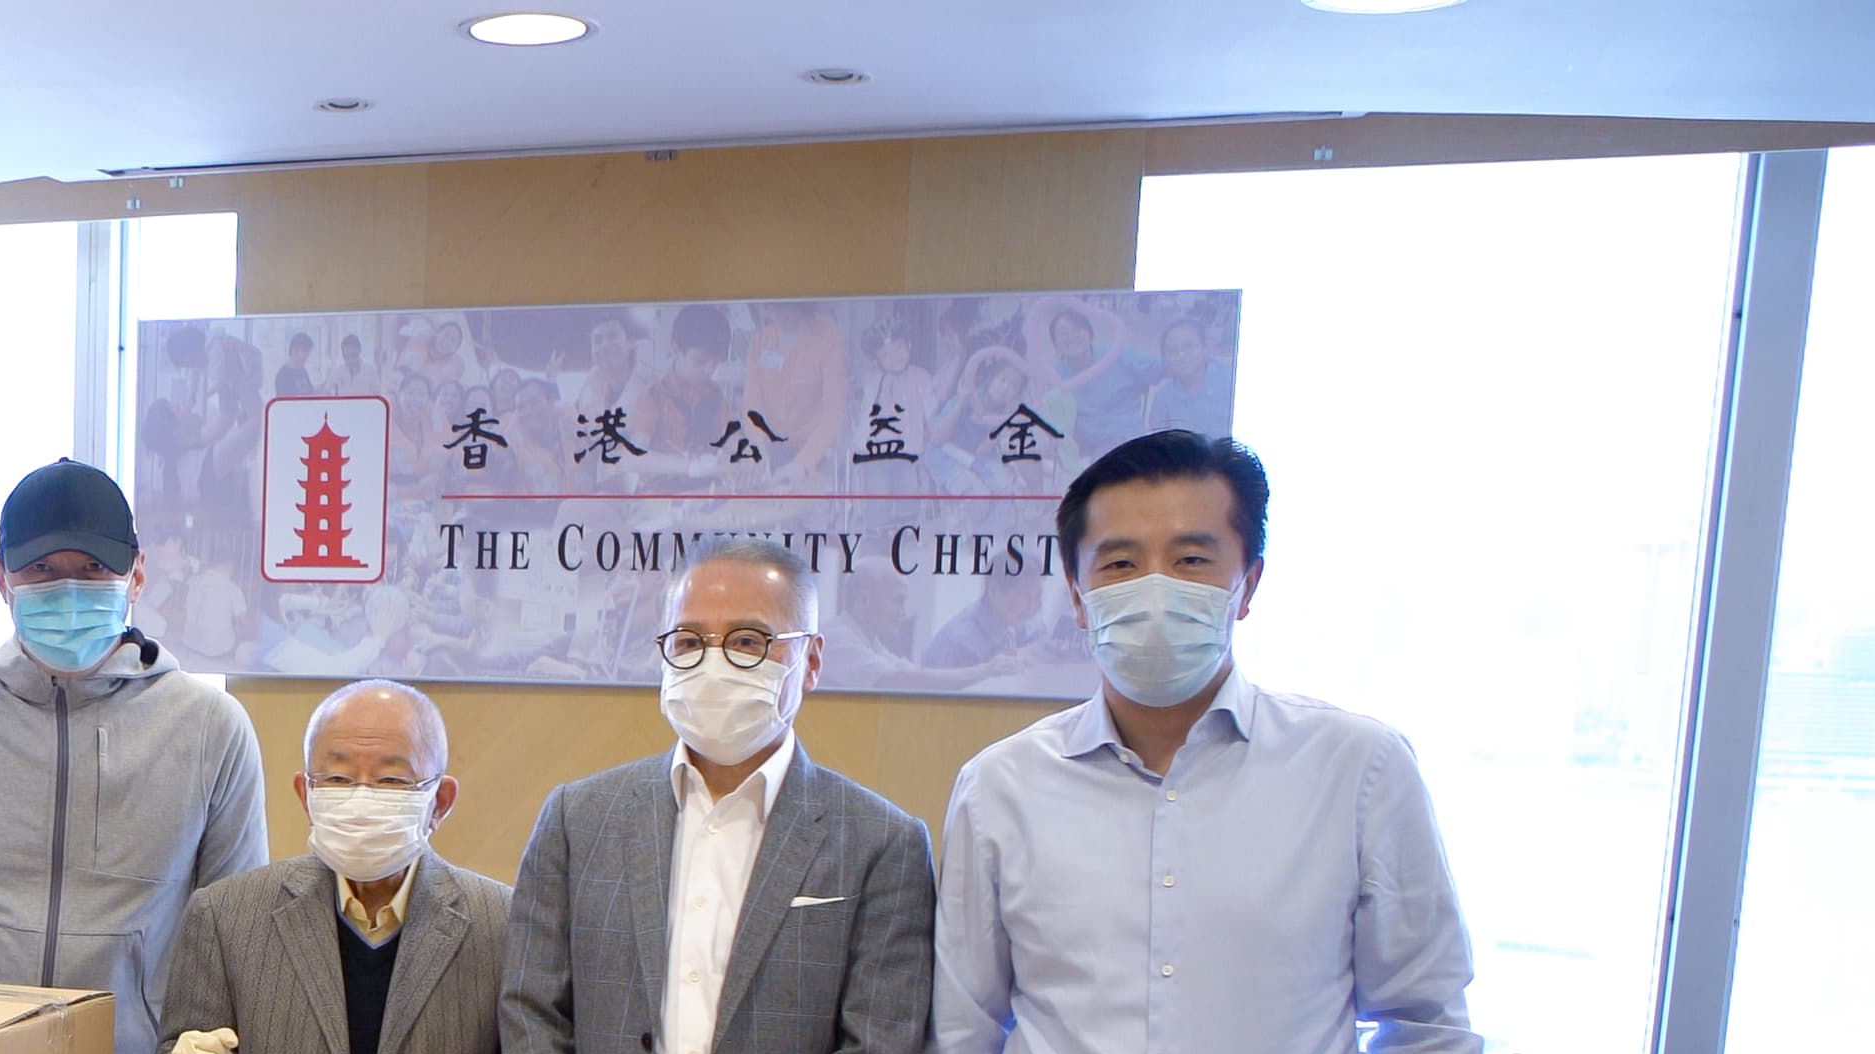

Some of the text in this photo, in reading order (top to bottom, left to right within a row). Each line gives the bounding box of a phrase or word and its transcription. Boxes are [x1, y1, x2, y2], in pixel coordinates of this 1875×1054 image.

[442, 402, 1065, 470] 香港公益金
[440, 523, 1060, 577] THE COMMTY CHEST
